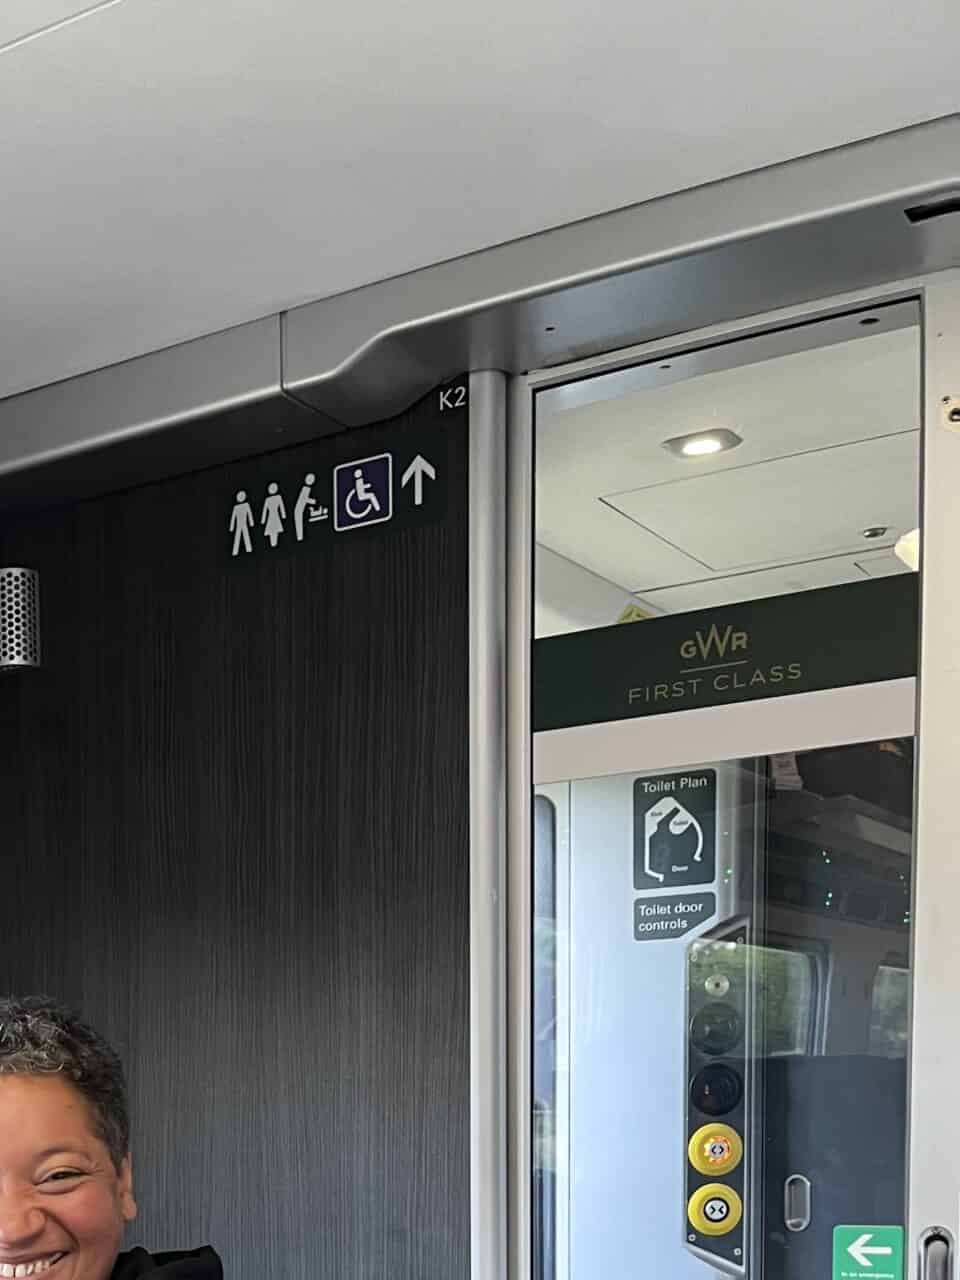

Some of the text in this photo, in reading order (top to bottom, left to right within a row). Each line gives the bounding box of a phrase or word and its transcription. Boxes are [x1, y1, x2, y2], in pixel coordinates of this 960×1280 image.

[439, 386, 466, 411] K2
[679, 623, 749, 660] GWR
[627, 663, 802, 704] FIRST CLASS
[641, 776, 708, 793] Toilet Plan
[639, 902, 703, 917] Toilet door
[638, 918, 689, 932] controls
